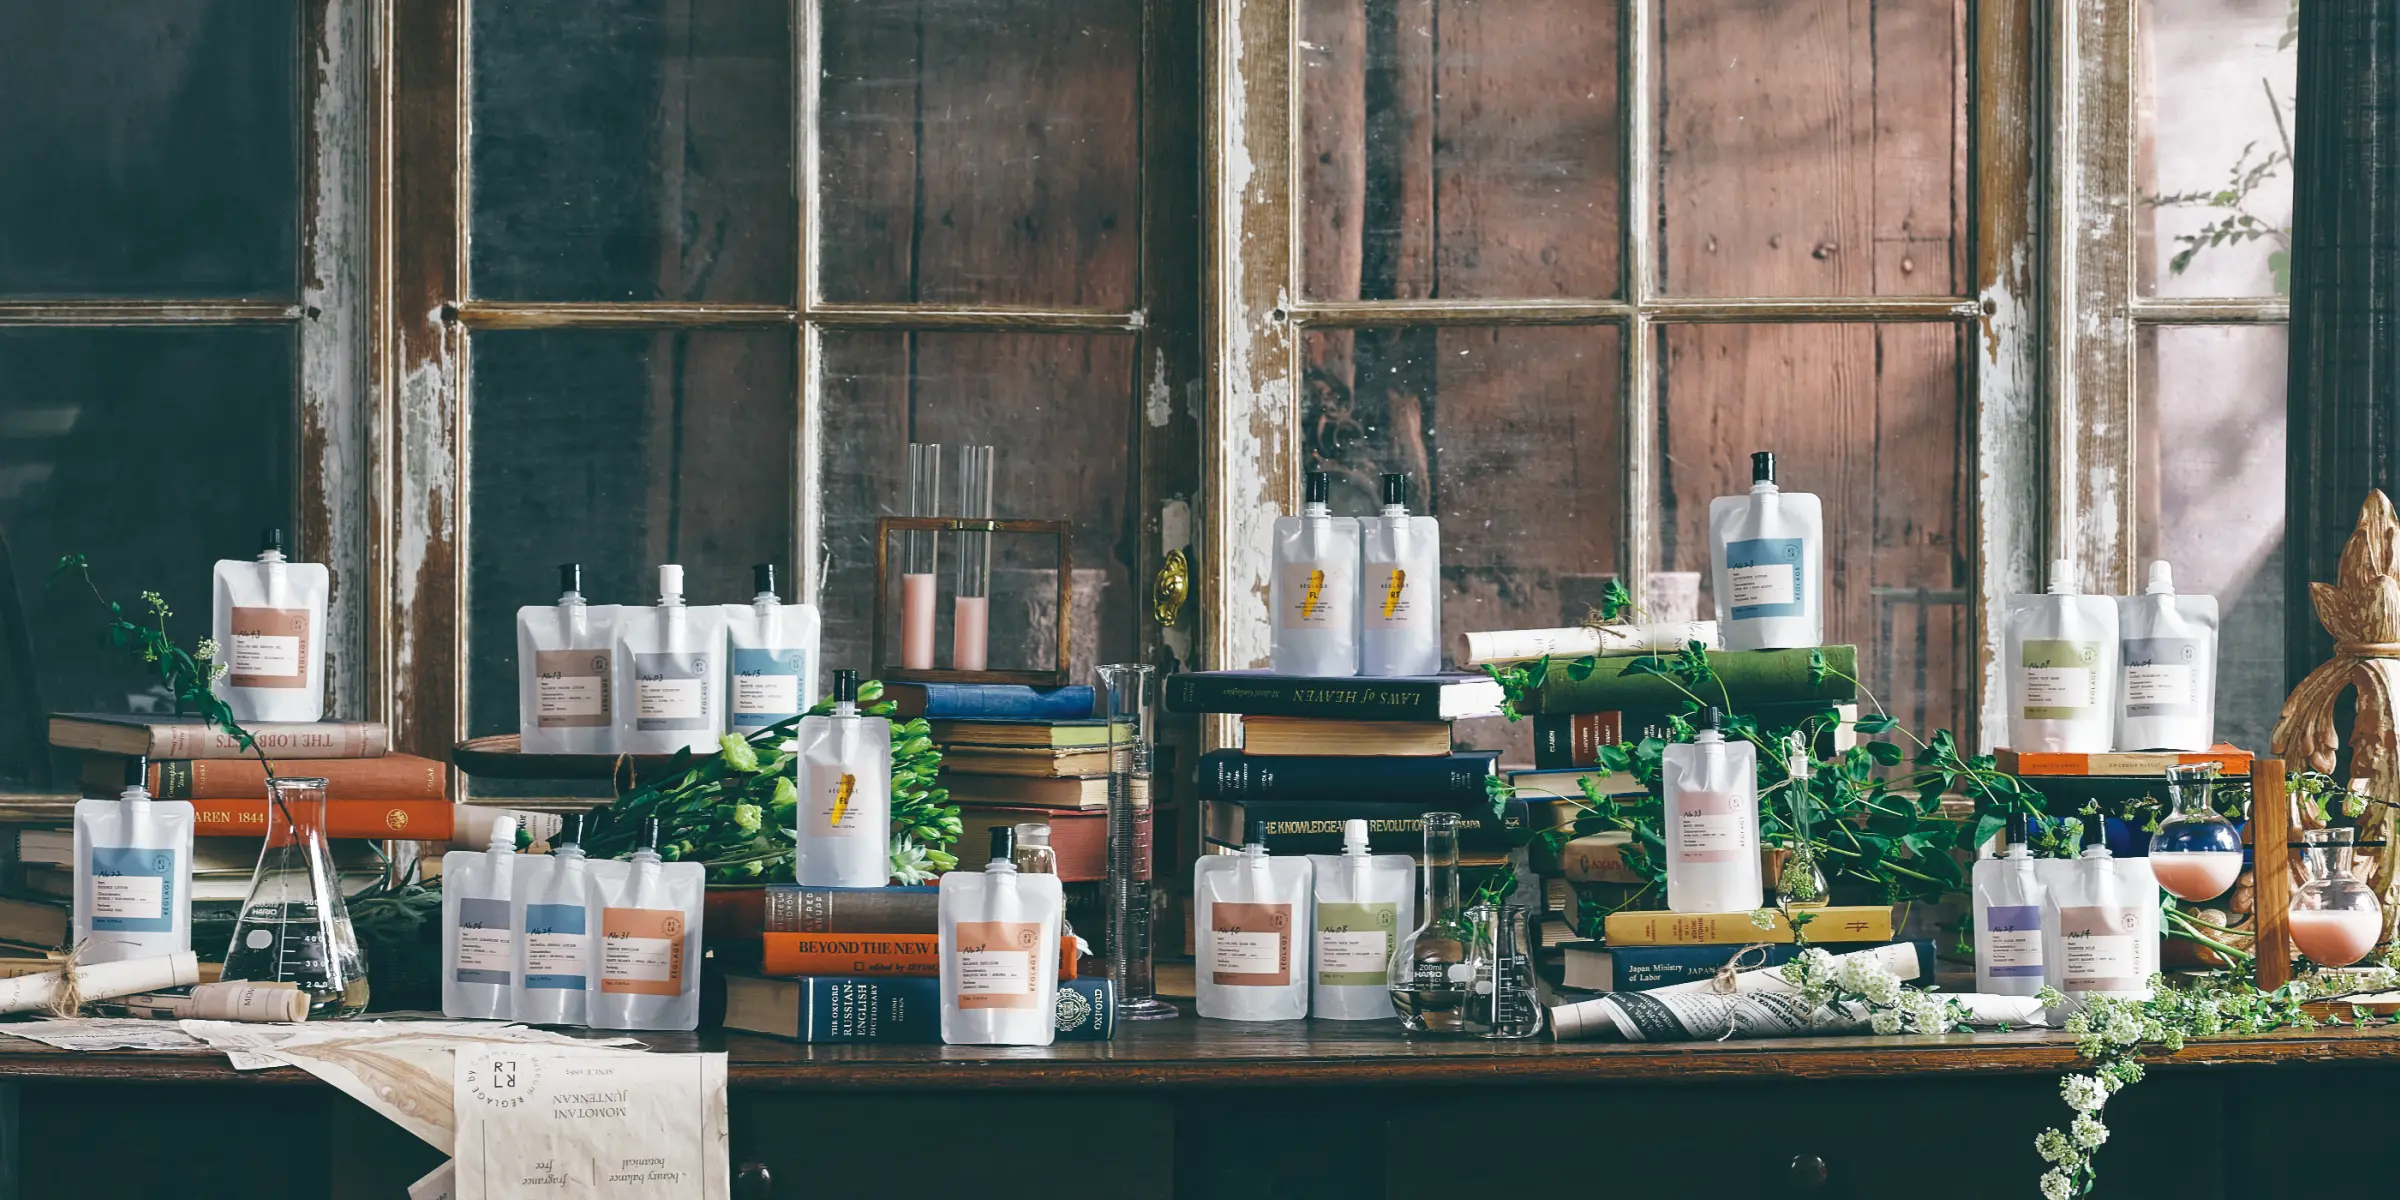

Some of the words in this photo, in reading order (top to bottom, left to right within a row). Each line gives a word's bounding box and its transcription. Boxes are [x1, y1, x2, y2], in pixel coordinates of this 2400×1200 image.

[1309, 591, 1318, 599] FL
[1292, 689, 1358, 704] HEAVEN
[1362, 688, 1375, 704] of
[1380, 692, 1421, 705] LAWS
[216, 734, 297, 748] LOBBTS
[302, 733, 333, 748] THE
[840, 796, 849, 804] FL
[194, 811, 230, 823] AREN
[238, 812, 264, 823] 1844
[1264, 820, 1277, 834] HE
[1278, 820, 1346, 834] KNOWLEDGE-V
[1455, 820, 1481, 829] AKAIYA
[800, 941, 860, 954] BEYOND
[860, 942, 892, 954] THE
[894, 942, 929, 954] NEW
[868, 962, 893, 971] edited
[895, 962, 905, 972] by
[1628, 964, 1650, 973] Japan
[1653, 963, 1683, 972] Ministry
[1628, 974, 1638, 982] of
[858, 984, 867, 1036] ENGLISH
[1094, 988, 1102, 1030] OXFORD
[466, 1070, 476, 1083] by
[472, 1086, 525, 1108] RÉGLAGE
[553, 1089, 628, 1104] JUNTENKAN
[554, 1107, 627, 1120] MOMOTANI
[535, 1159, 554, 1172] free
[622, 1158, 666, 1170] botanical
[522, 1174, 568, 1188] fragrance
[608, 1173, 645, 1184] balance
[646, 1171, 680, 1184] beauty
